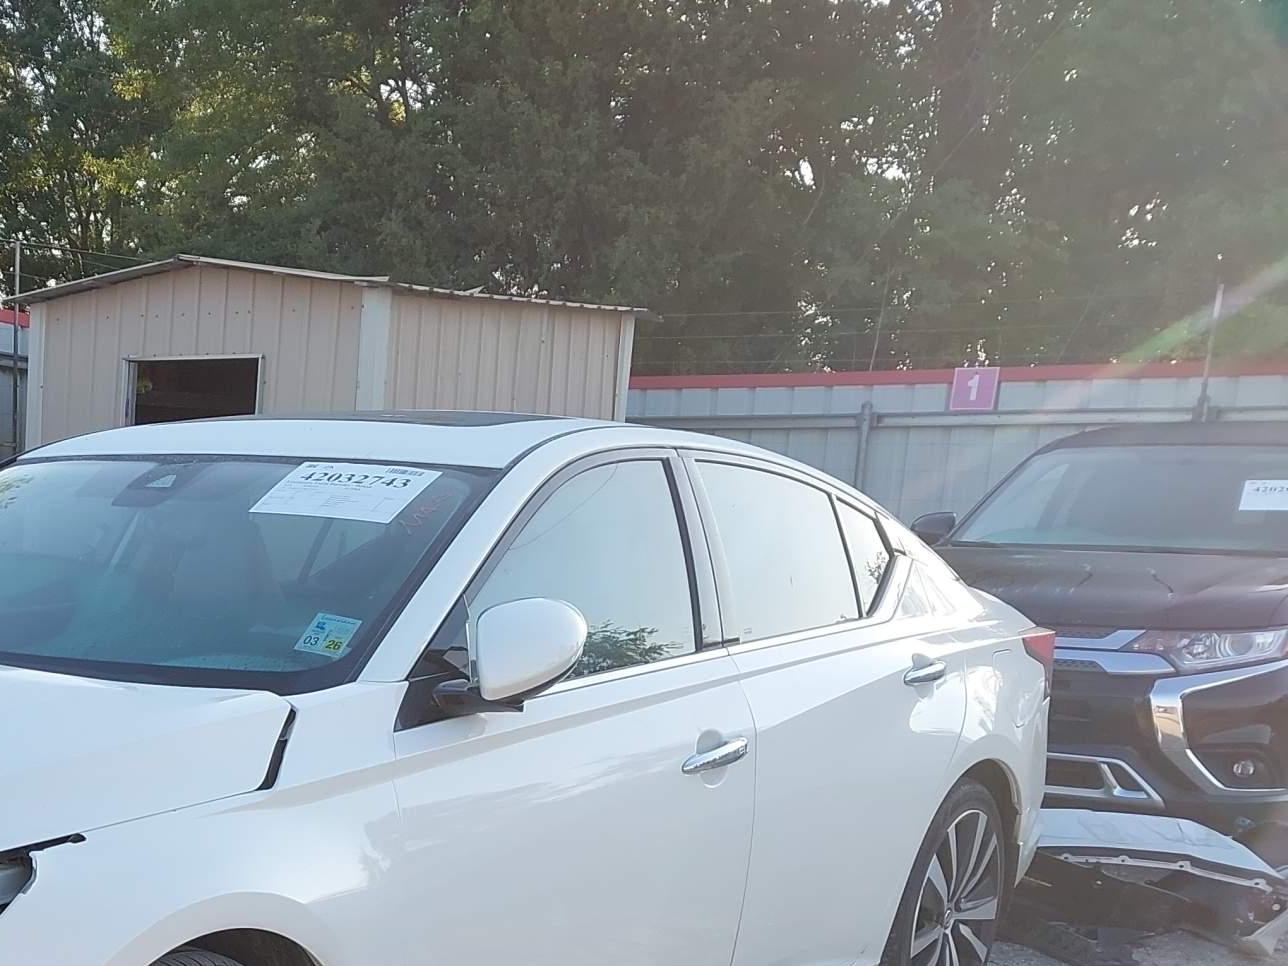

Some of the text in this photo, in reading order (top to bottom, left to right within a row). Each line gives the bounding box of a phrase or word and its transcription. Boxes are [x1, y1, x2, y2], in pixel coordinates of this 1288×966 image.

[967, 374, 980, 401] 1
[300, 471, 412, 489] 42032743
[303, 635, 343, 651] 03 26
